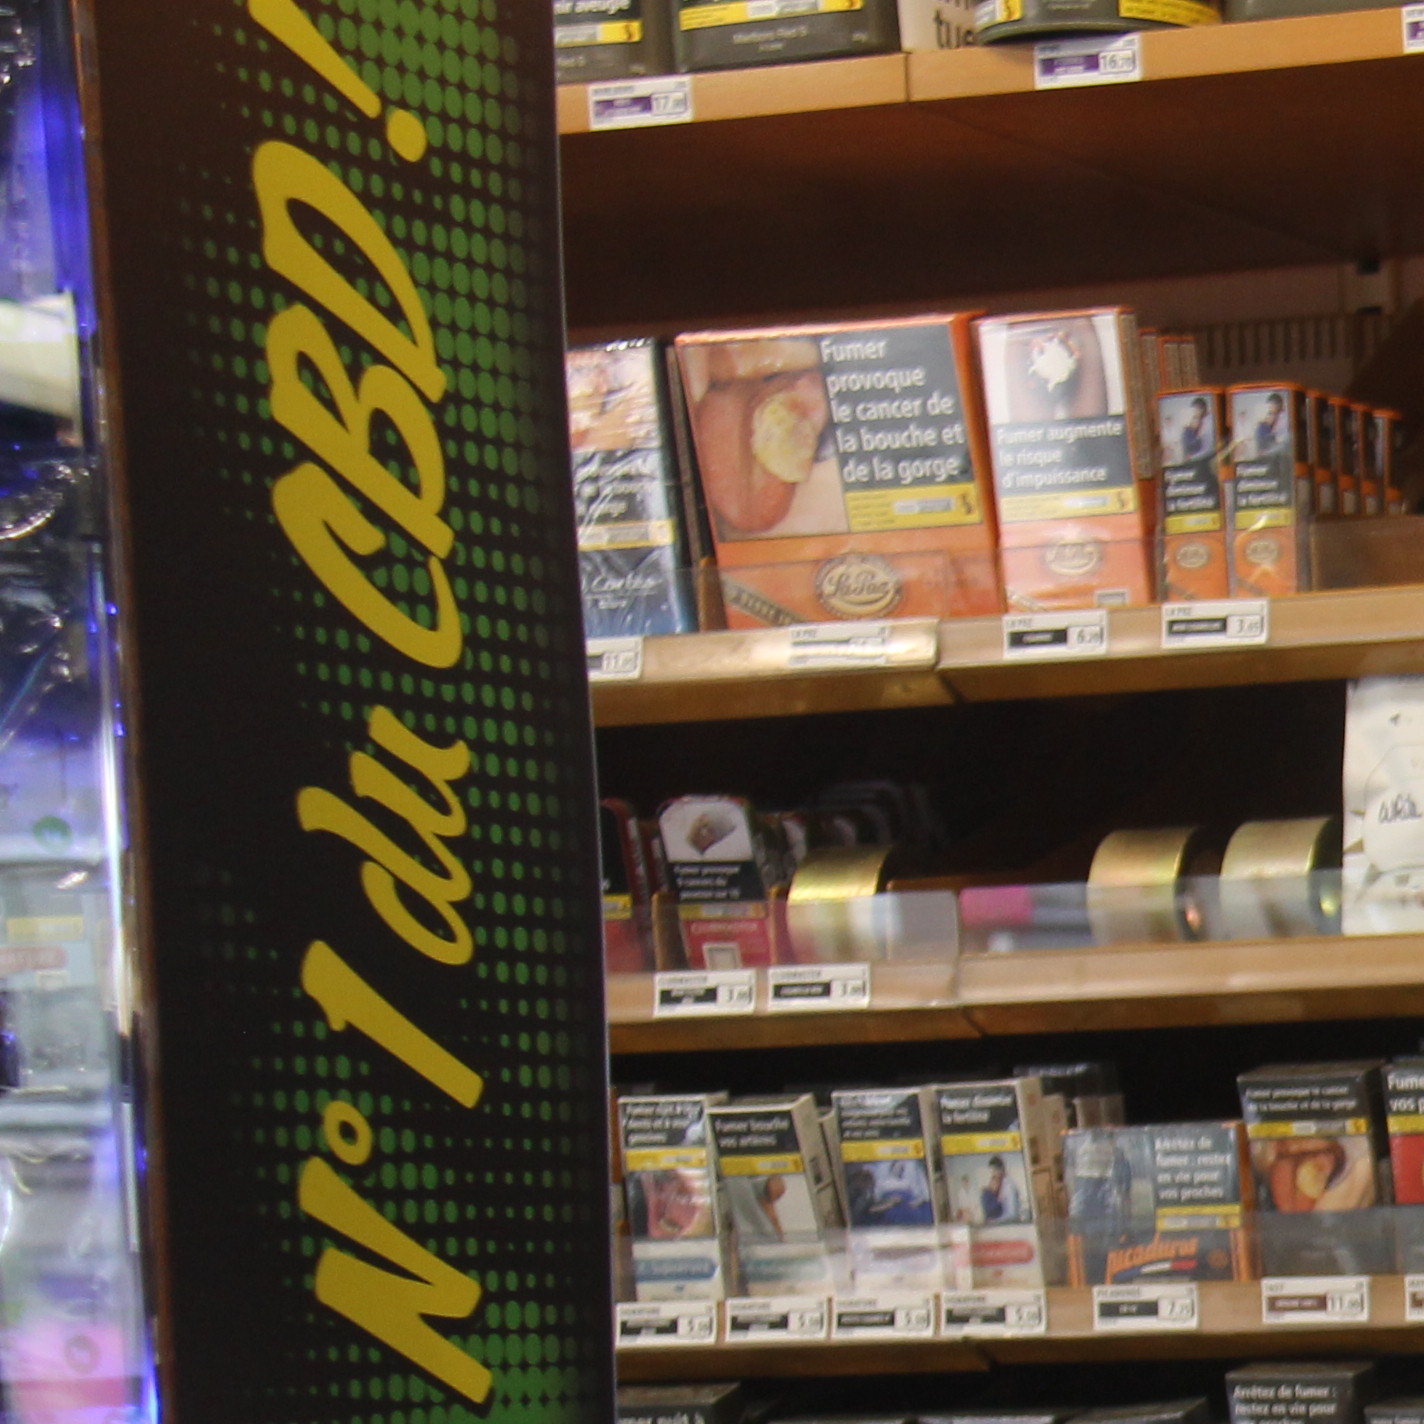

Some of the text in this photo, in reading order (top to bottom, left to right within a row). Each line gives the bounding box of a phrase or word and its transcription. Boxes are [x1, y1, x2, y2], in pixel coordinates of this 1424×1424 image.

[819, 338, 888, 363] Fumer
[826, 367, 926, 398] provoque
[831, 393, 954, 423] le cancer de
[836, 424, 964, 454] la bouche et
[997, 420, 1123, 444] Fumer augmente
[842, 456, 959, 486] de la gorge
[1002, 466, 1107, 490] d'impuissance
[297, 704, 473, 966] du
[1390, 1097, 1415, 1112] vos
